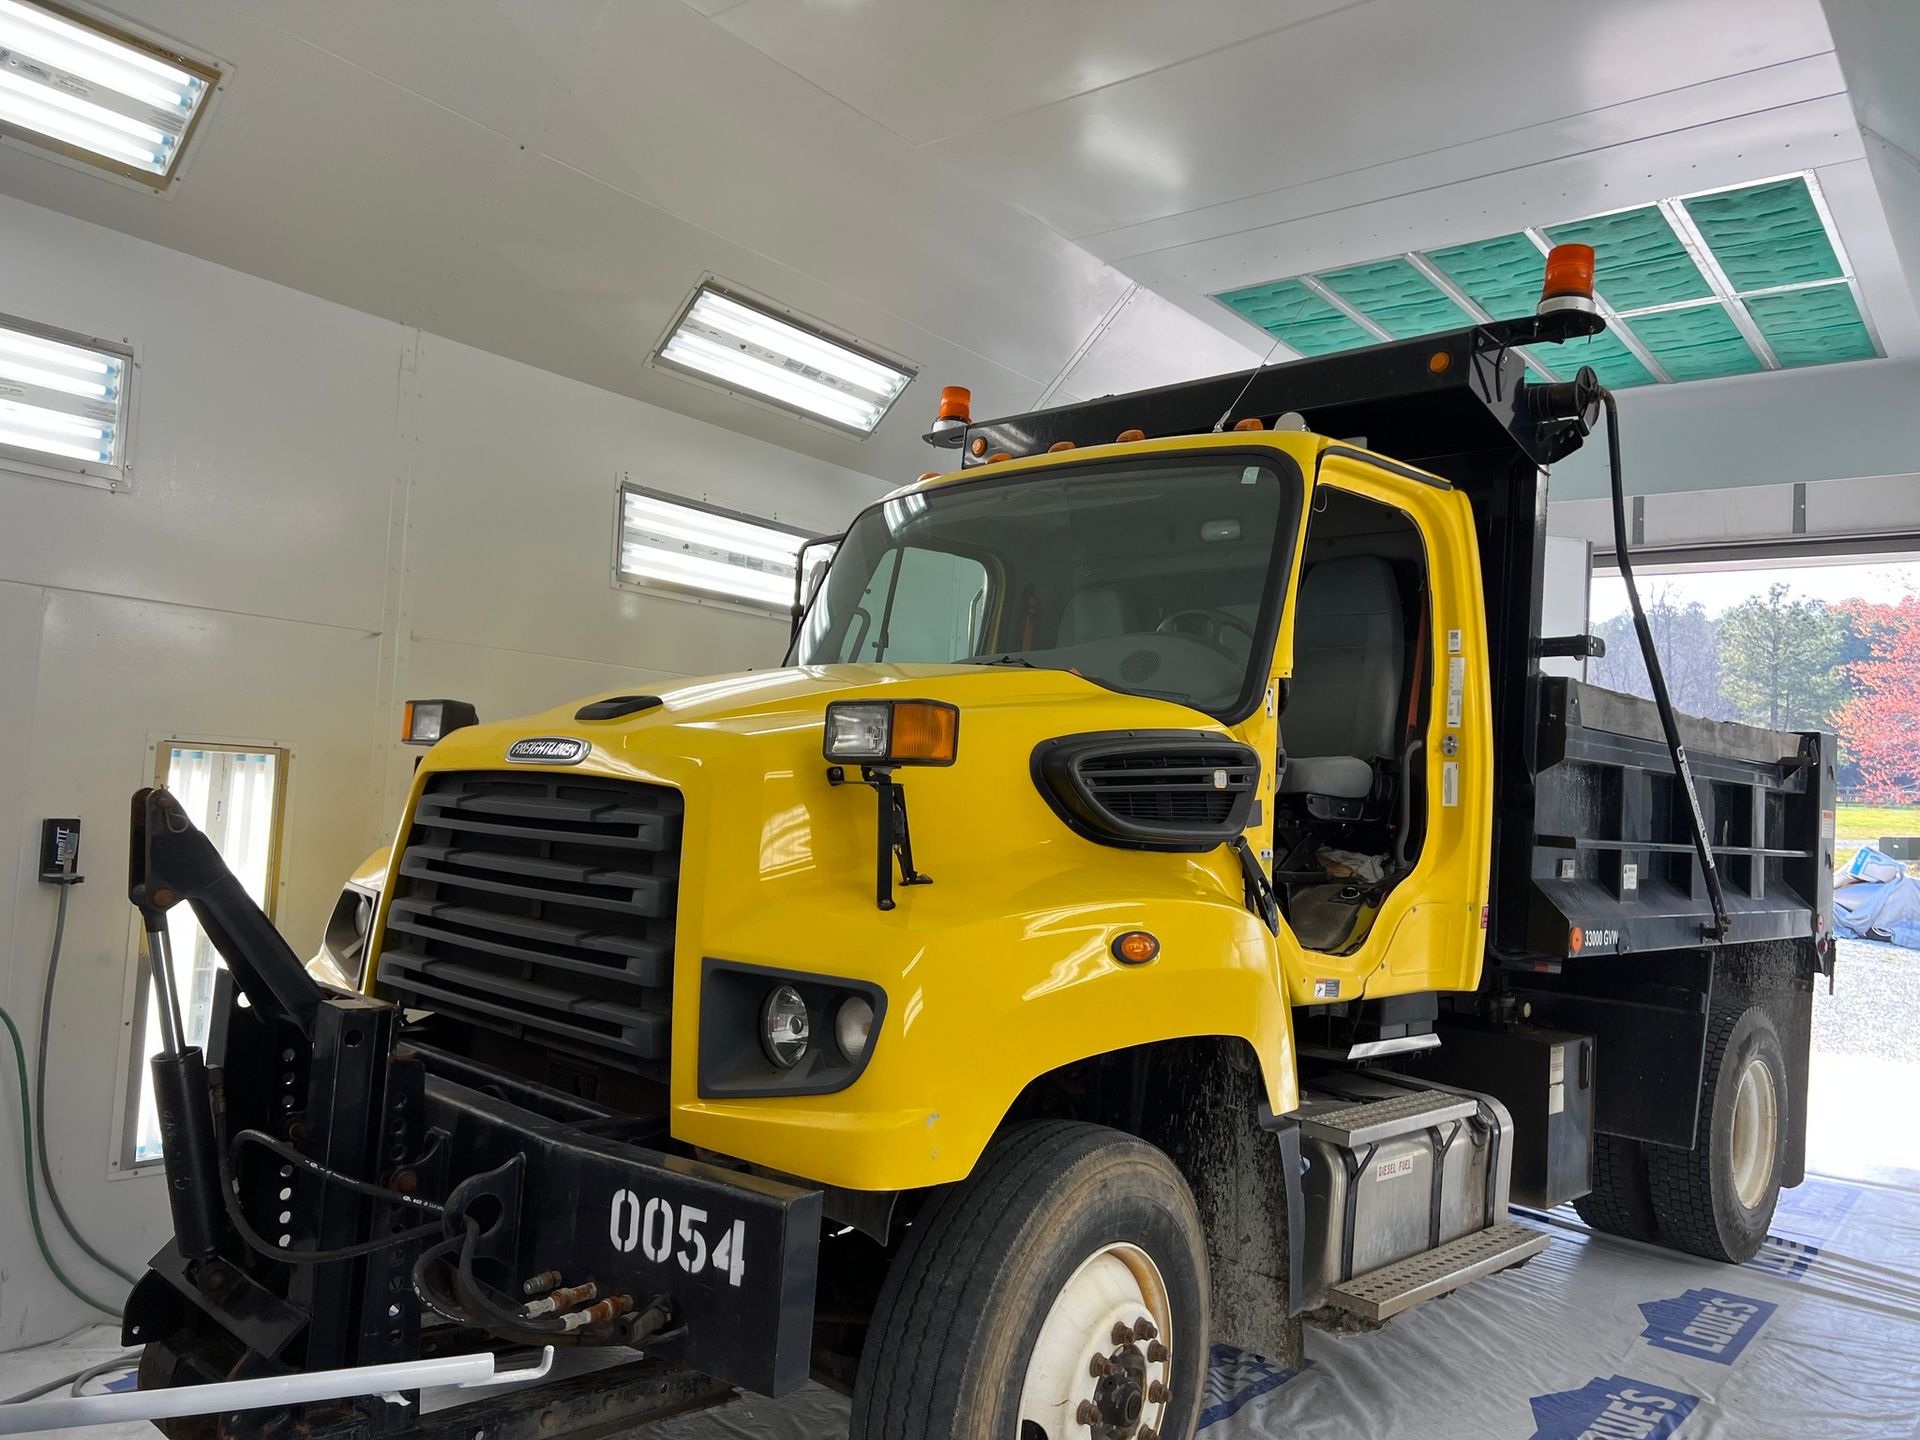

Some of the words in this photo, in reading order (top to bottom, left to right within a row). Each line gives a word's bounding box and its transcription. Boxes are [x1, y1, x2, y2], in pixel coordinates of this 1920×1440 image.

[511, 742, 578, 756] FREIGHTLINER
[1585, 931, 1602, 947] 33000
[1603, 929, 1619, 946] GVW
[1378, 1164, 1396, 1177] DIESEL
[1399, 1160, 1411, 1172] FUEL
[610, 1188, 746, 1287] 0054
[1664, 1297, 1759, 1354] LOWE'S
